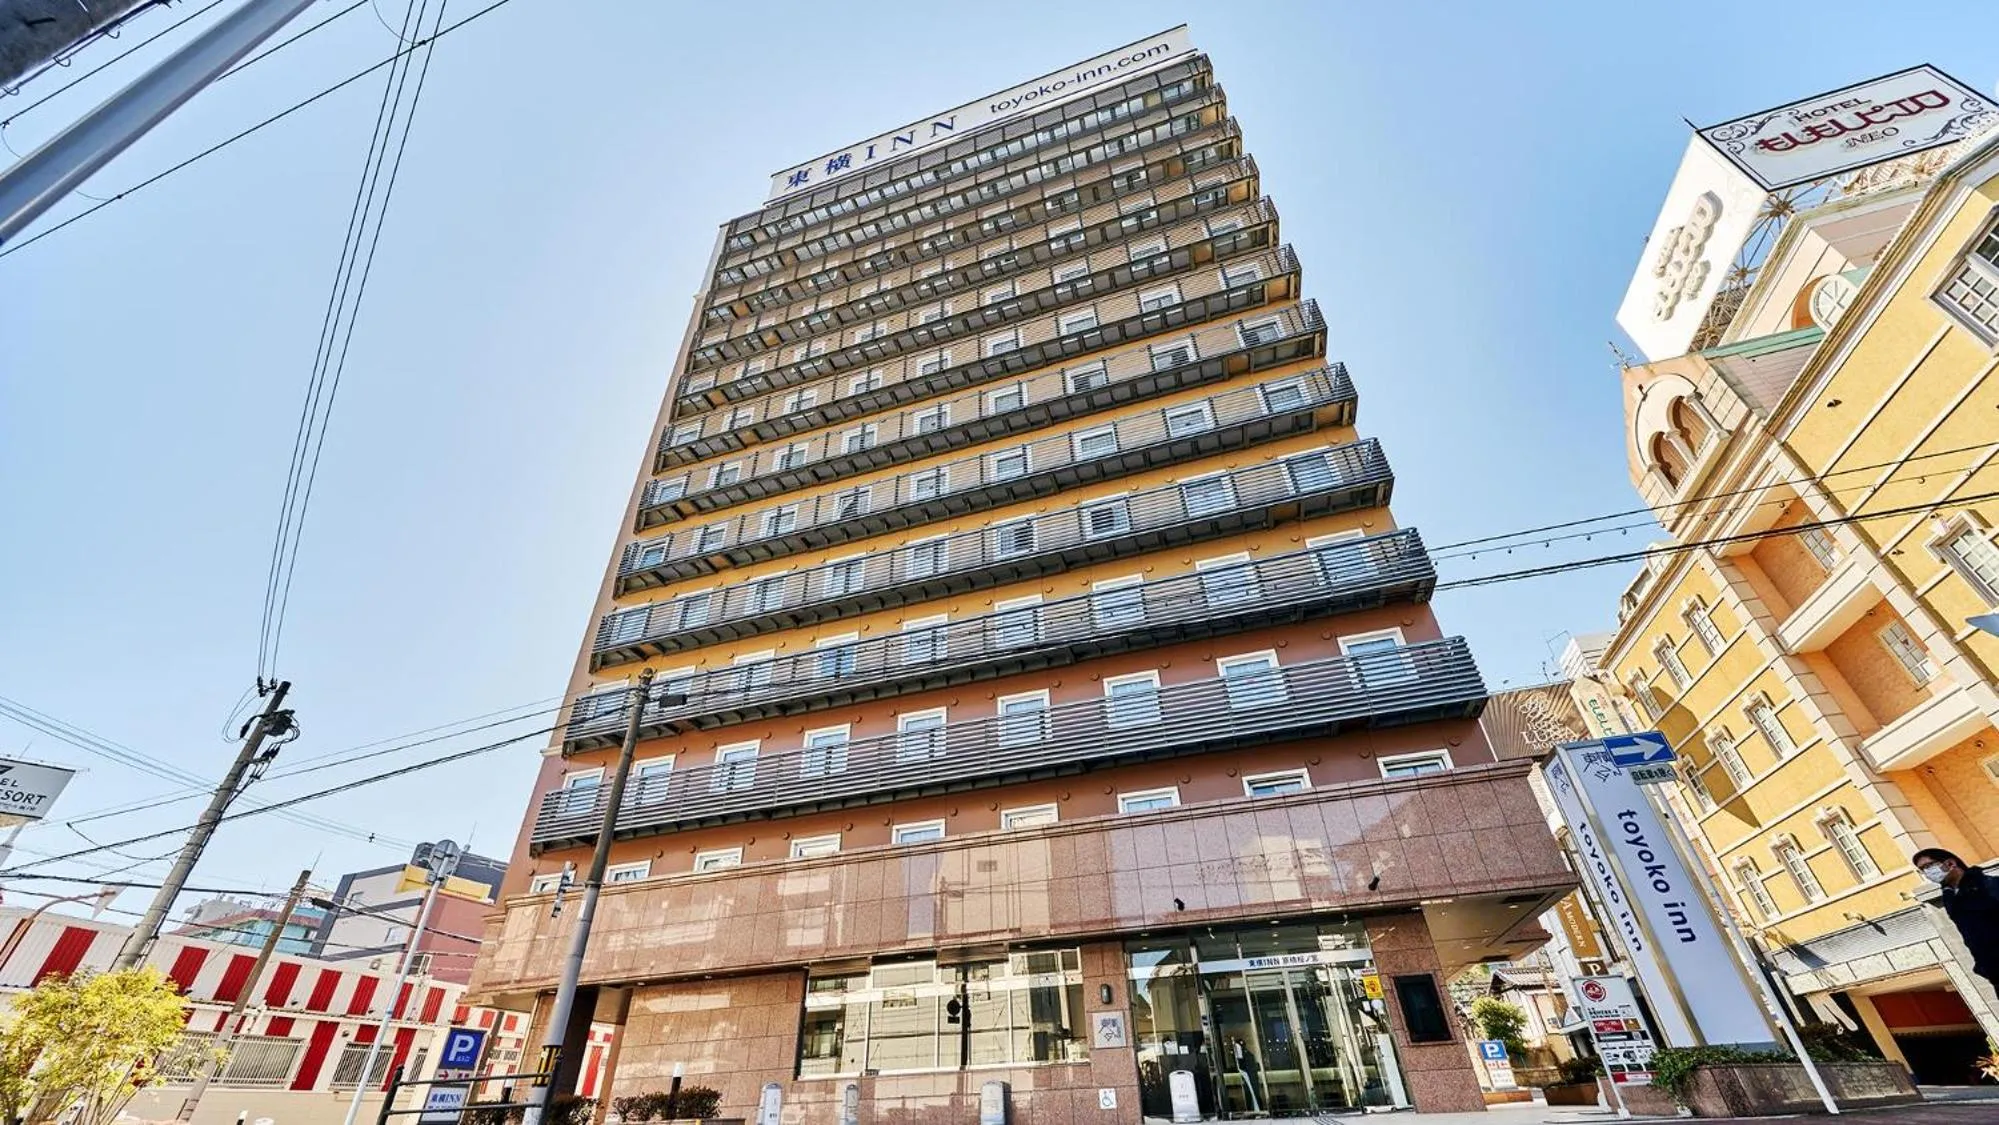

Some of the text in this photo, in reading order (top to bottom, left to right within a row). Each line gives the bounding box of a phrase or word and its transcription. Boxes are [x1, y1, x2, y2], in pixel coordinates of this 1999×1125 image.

[990, 41, 1170, 113] toyoko-inn.com
[1796, 98, 1873, 122] HOTEL
[1846, 127, 1899, 147] NEO
[1580, 822, 1642, 951] toyoko inn
[1618, 809, 1696, 943] toyoko inn
[1587, 963, 1602, 977] P
[447, 1034, 475, 1062] P
[1484, 1043, 1503, 1058] P
